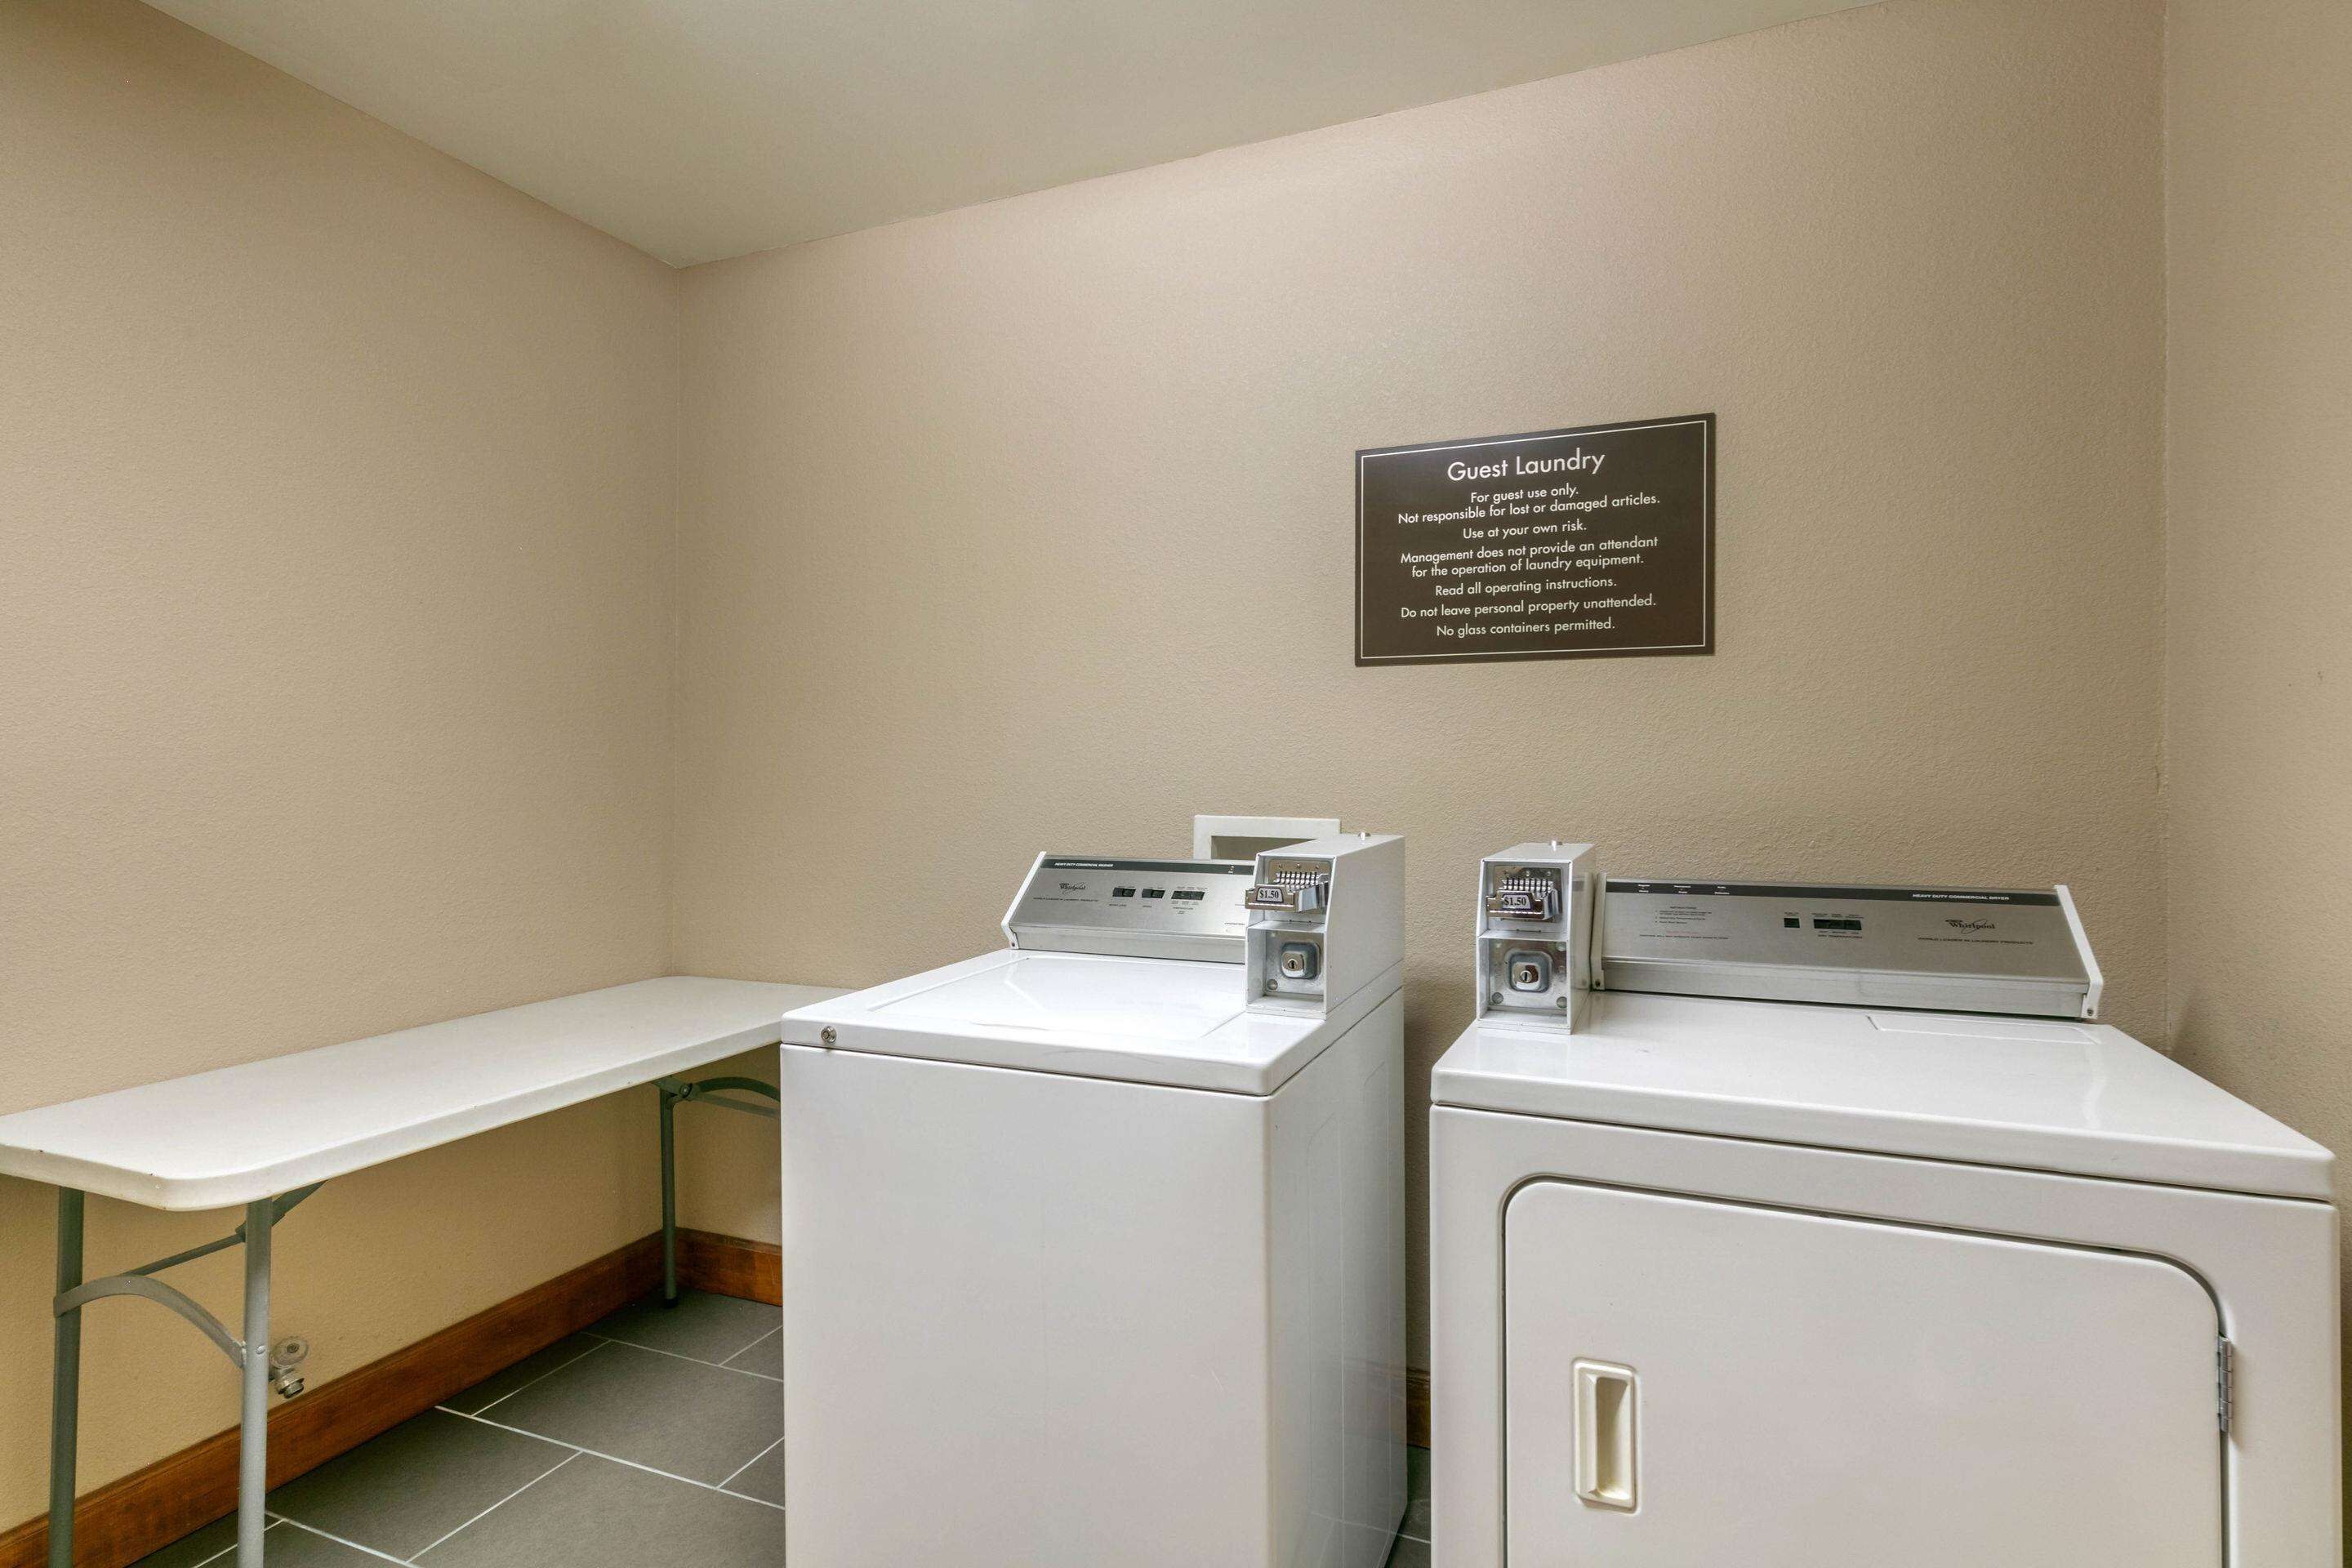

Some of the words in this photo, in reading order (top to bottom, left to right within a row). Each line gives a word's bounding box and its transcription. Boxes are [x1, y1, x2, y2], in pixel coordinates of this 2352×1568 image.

[1447, 460, 1508, 481] Guest
[1517, 448, 1606, 475] Laundry
[1471, 492, 1490, 503] For
[1493, 489, 1524, 504] guest
[1527, 489, 1547, 498] use
[1551, 483, 1579, 498] only.
[1398, 513, 1419, 523] Not
[1423, 506, 1486, 523] responsible
[1490, 504, 1506, 516] for
[1510, 503, 1530, 514] lost
[1533, 505, 1546, 513] or
[1550, 495, 1607, 512] damaged
[1611, 492, 1659, 506] articles.
[1463, 528, 1484, 539] Use
[1487, 527, 1499, 537] at
[1502, 527, 1529, 539] your
[1533, 525, 1557, 534] own
[1562, 519, 1587, 532] risk.
[1401, 550, 1473, 564] Management
[1477, 546, 1503, 559] does
[1508, 546, 1526, 556] not
[1530, 540, 1575, 558] provide
[1579, 543, 1594, 551] an
[1599, 535, 1658, 550] attendant
[1412, 565, 1428, 577] for
[1431, 564, 1448, 576] the
[1451, 562, 1506, 577] operation
[1510, 559, 1522, 571] of
[1526, 556, 1572, 571] laundry
[1576, 554, 1643, 569] equipment.
[1436, 583, 1463, 596] Read
[1468, 581, 1481, 595] all
[1485, 581, 1541, 596] operating
[1546, 577, 1616, 590] instructions.
[1401, 608, 1417, 617] Do
[1420, 607, 1438, 617] not
[1441, 604, 1471, 616] leave
[1475, 599, 1524, 617] personal
[1529, 600, 1579, 614] property
[1584, 593, 1655, 608] unattended.
[1437, 626, 1454, 636] No
[1458, 623, 1486, 638] glass
[1490, 622, 1550, 634] containers
[1555, 617, 1615, 635] permitted.
[1259, 889, 1279, 898] $1.50
[1504, 897, 1527, 906] $1.50
[1944, 919, 1997, 933] Whirlpool
